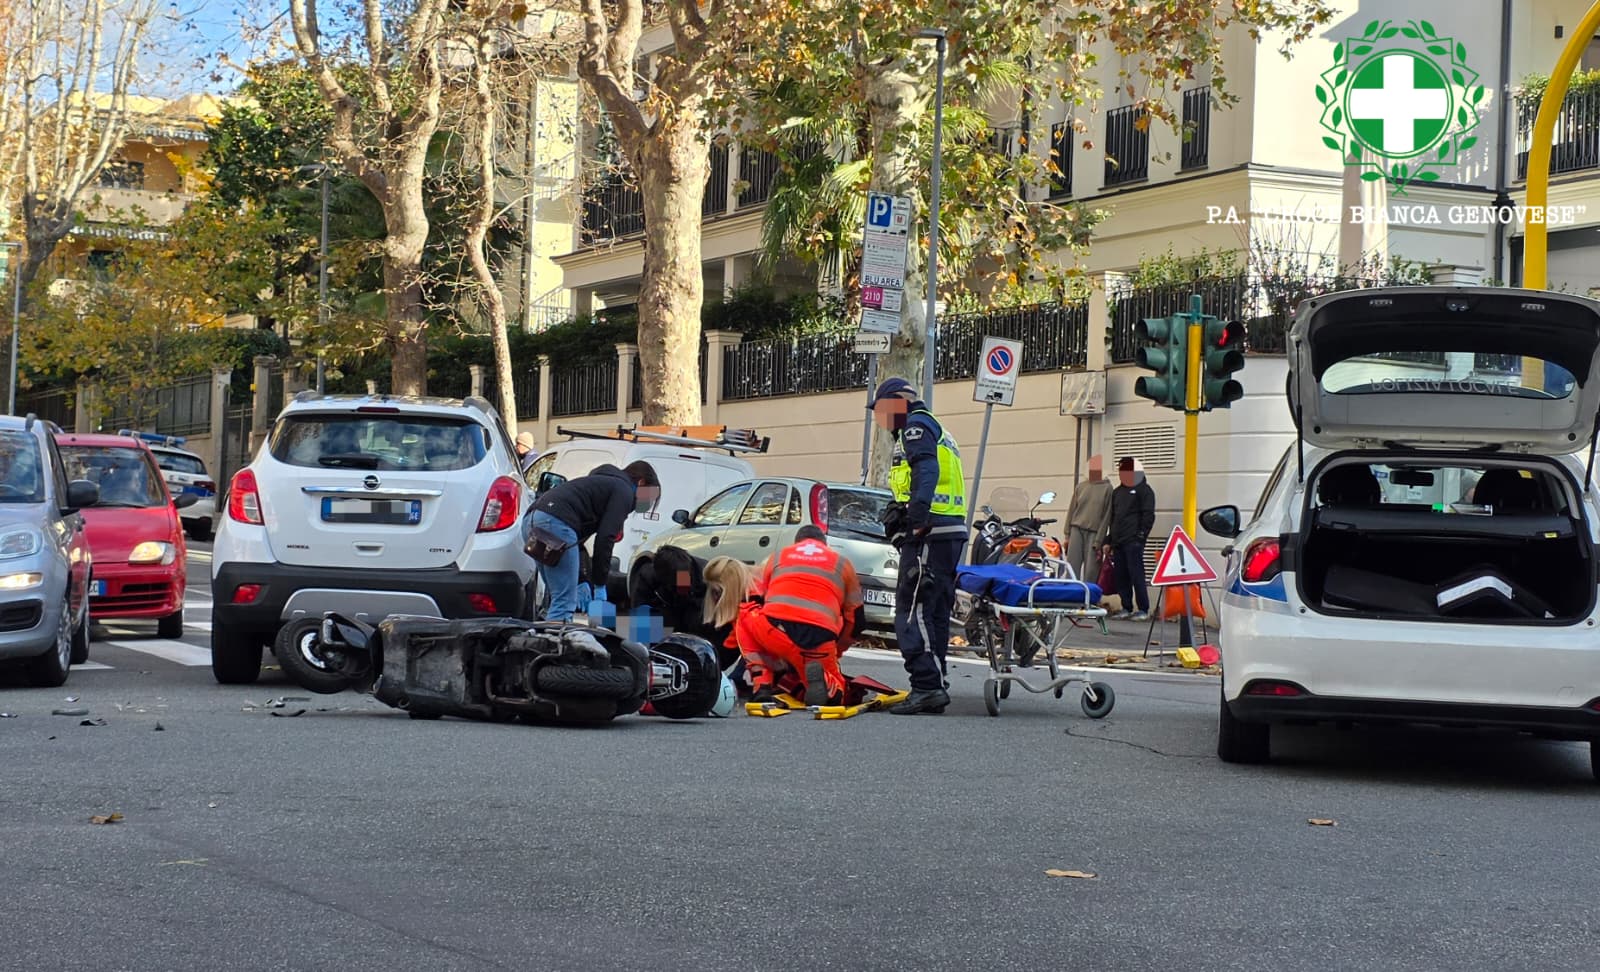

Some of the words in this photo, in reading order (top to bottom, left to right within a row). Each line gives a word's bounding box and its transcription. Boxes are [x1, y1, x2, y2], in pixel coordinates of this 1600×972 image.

[873, 199, 888, 223] P
[865, 275, 879, 286] BLU
[880, 277, 900, 287] AREA
[864, 292, 881, 302] 2110
